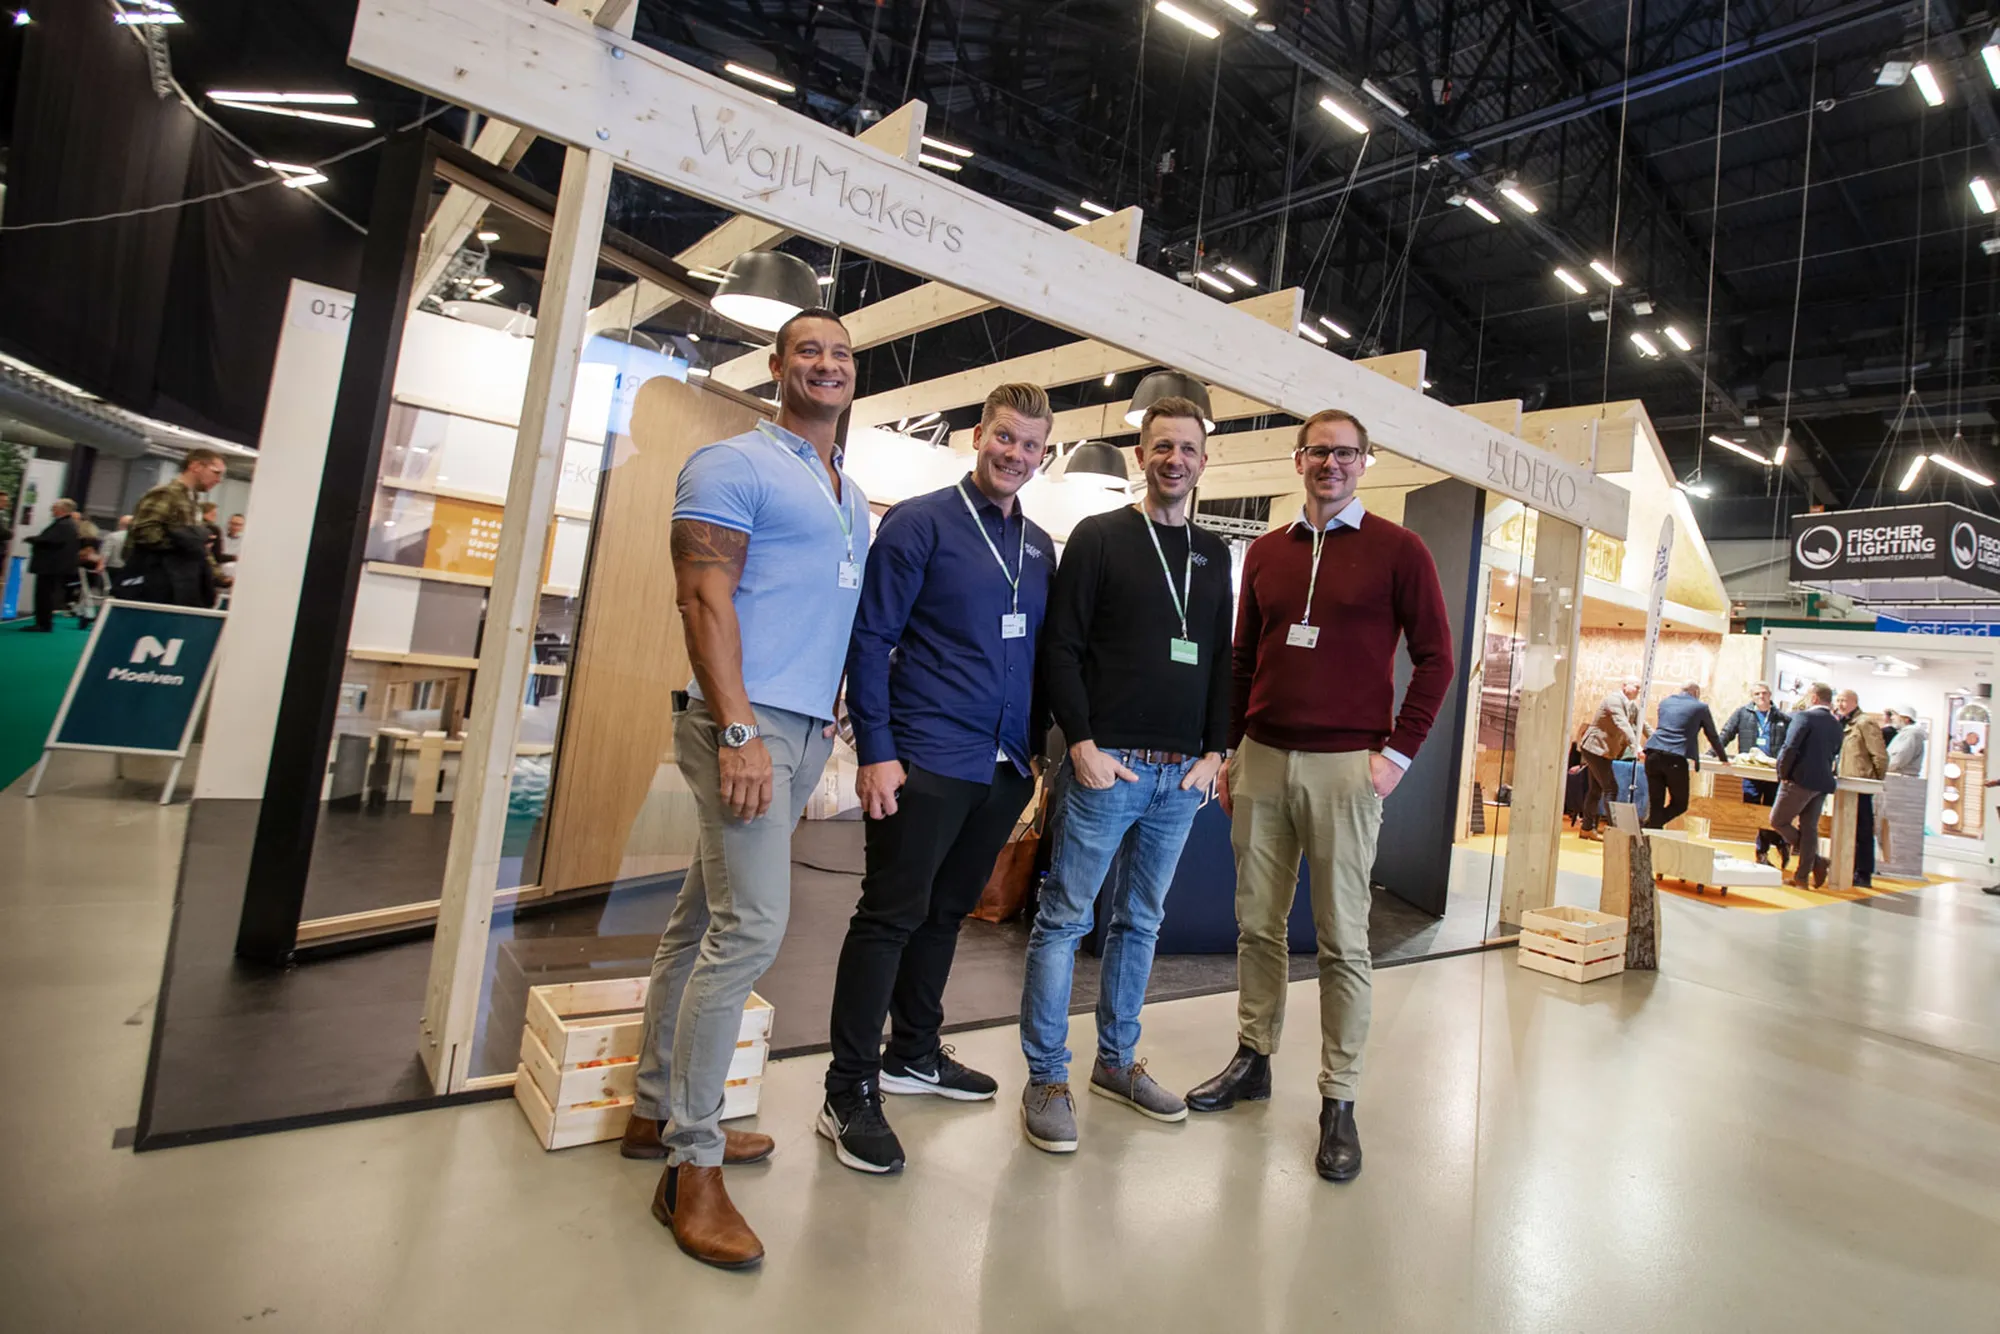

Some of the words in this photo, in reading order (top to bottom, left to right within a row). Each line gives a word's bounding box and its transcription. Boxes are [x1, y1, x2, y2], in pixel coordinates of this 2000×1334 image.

[311, 299, 354, 321] 017
[1512, 449, 1577, 511] DEKO
[1847, 525, 1923, 544] FISCHER
[1846, 538, 1937, 556] LIGHTING
[1868, 554, 1904, 562] BRIGHTER
[1905, 552, 1936, 560] FUTURE
[108, 667, 185, 686] Moelven
[1630, 655, 1700, 679] nrdic
